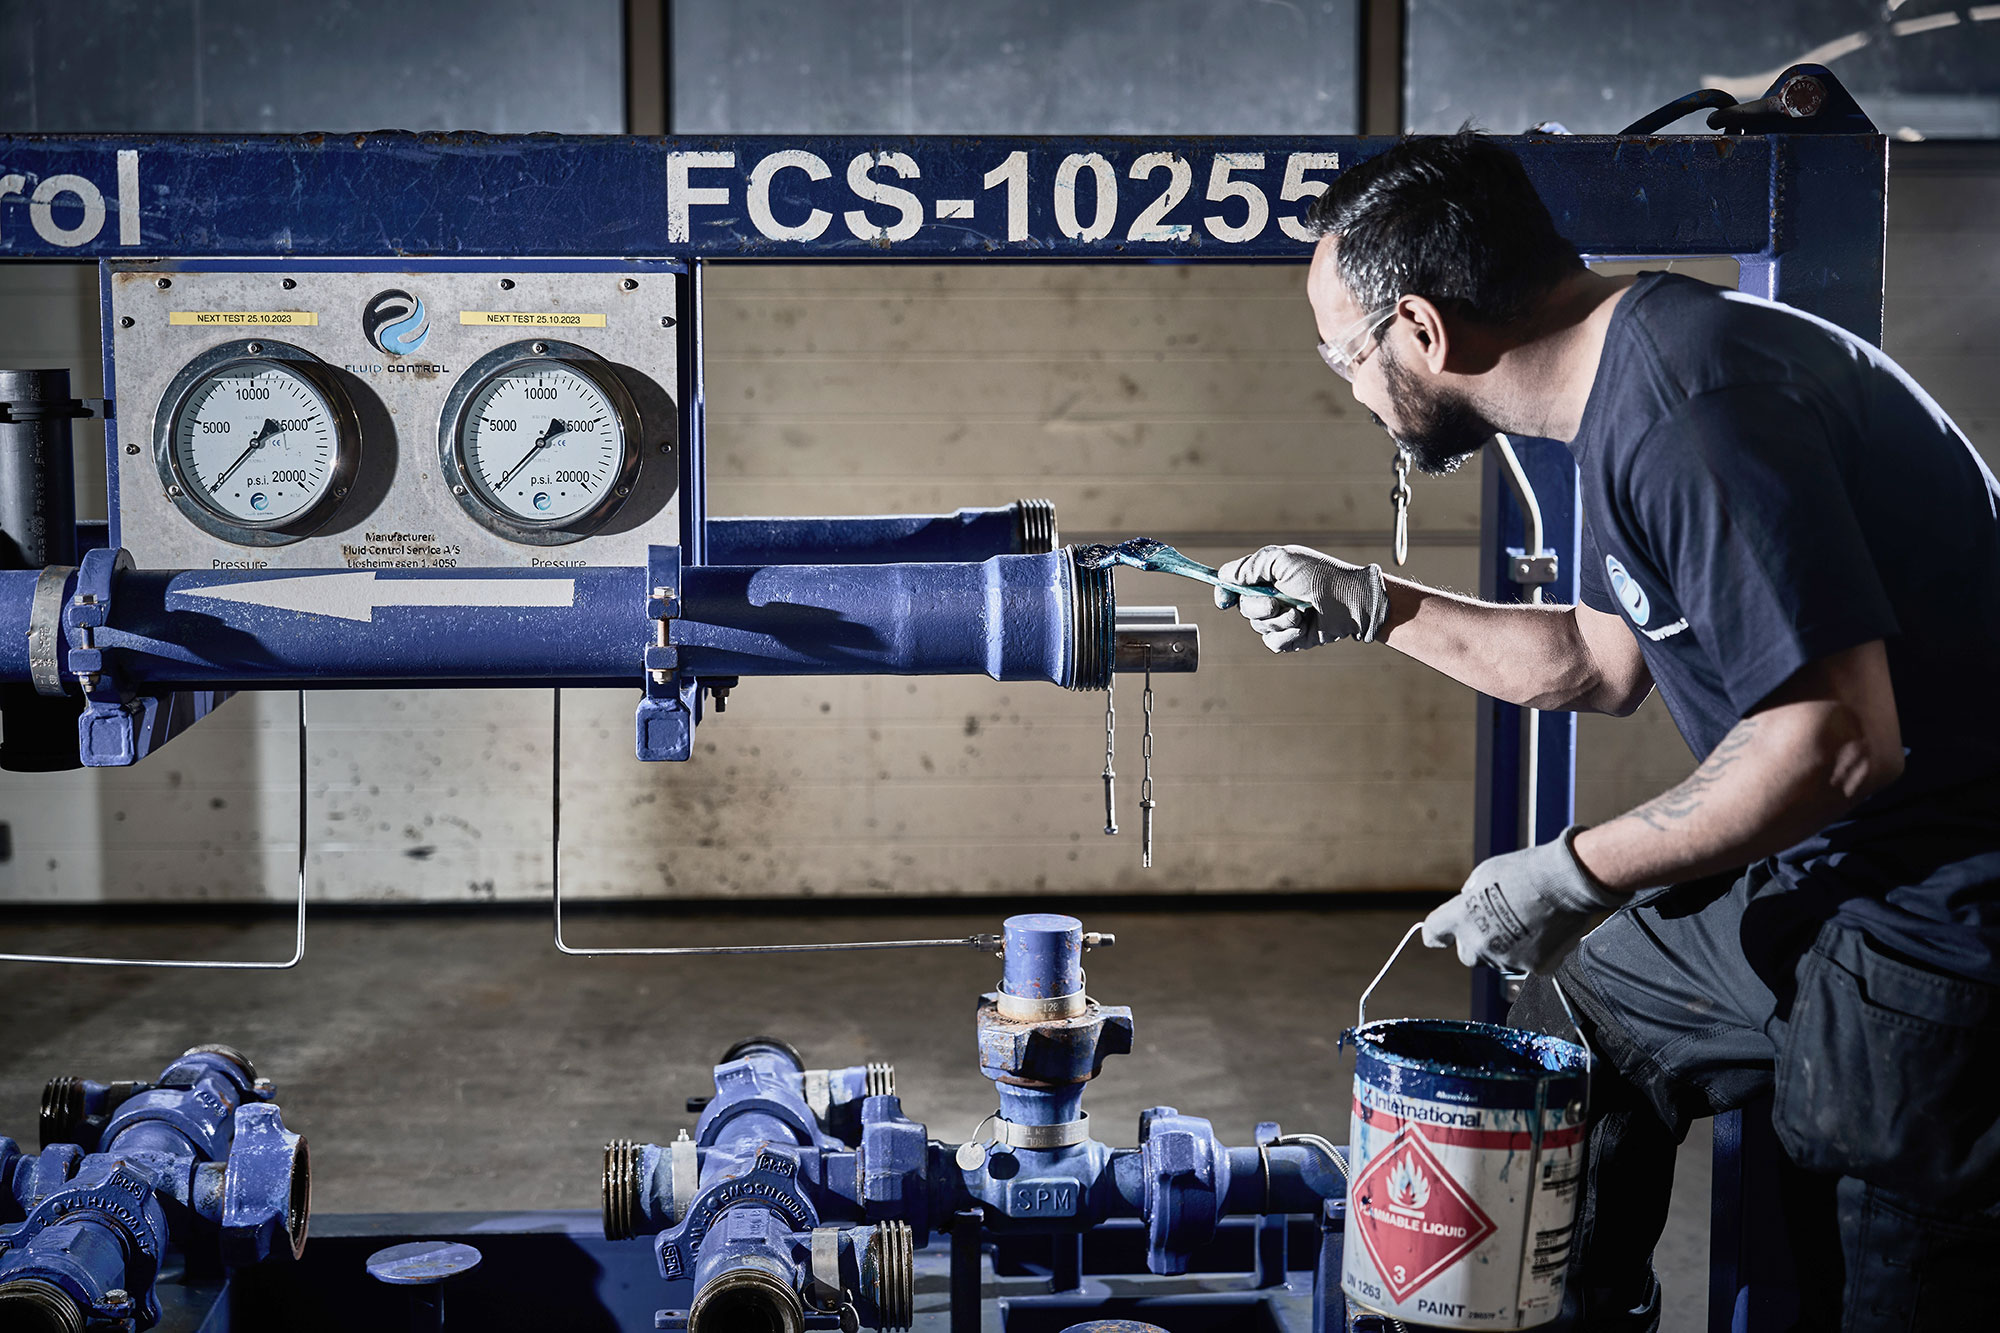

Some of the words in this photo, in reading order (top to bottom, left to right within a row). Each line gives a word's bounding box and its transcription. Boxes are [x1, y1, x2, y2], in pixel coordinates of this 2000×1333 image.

[666, 149, 1339, 244] FCS-10255
[197, 314, 220, 323] NEXT
[223, 314, 245, 323] TEST
[247, 314, 292, 323] 25.10.2023
[487, 314, 510, 323] NEXT
[512, 315, 535, 324] TEST
[536, 315, 581, 324] 25.10.2023
[345, 364, 382, 373] FLUID
[387, 364, 450, 373] CONTROL
[235, 388, 270, 400] 10000
[524, 387, 558, 400] 10000
[202, 421, 231, 434] 5000
[277, 418, 309, 431] 5000
[489, 419, 517, 432] 5000
[564, 419, 594, 432] 5000
[247, 475, 269, 488] p.s.i.
[272, 470, 307, 483] 20000
[530, 474, 553, 487] p.s.i.
[555, 470, 590, 483] 20000
[368, 545, 405, 555] Control
[406, 545, 441, 555] Service
[443, 545, 461, 556] A/S
[212, 559, 268, 570] Pressure
[432, 559, 457, 569] 4050
[531, 557, 587, 568] Pressure
[1018, 1188, 1071, 1210] SPM
[1422, 1222, 1467, 1239] LIQUID
[1393, 1265, 1406, 1284] 3
[1358, 1280, 1381, 1300] 1263
[1418, 1299, 1466, 1318] PAINT
